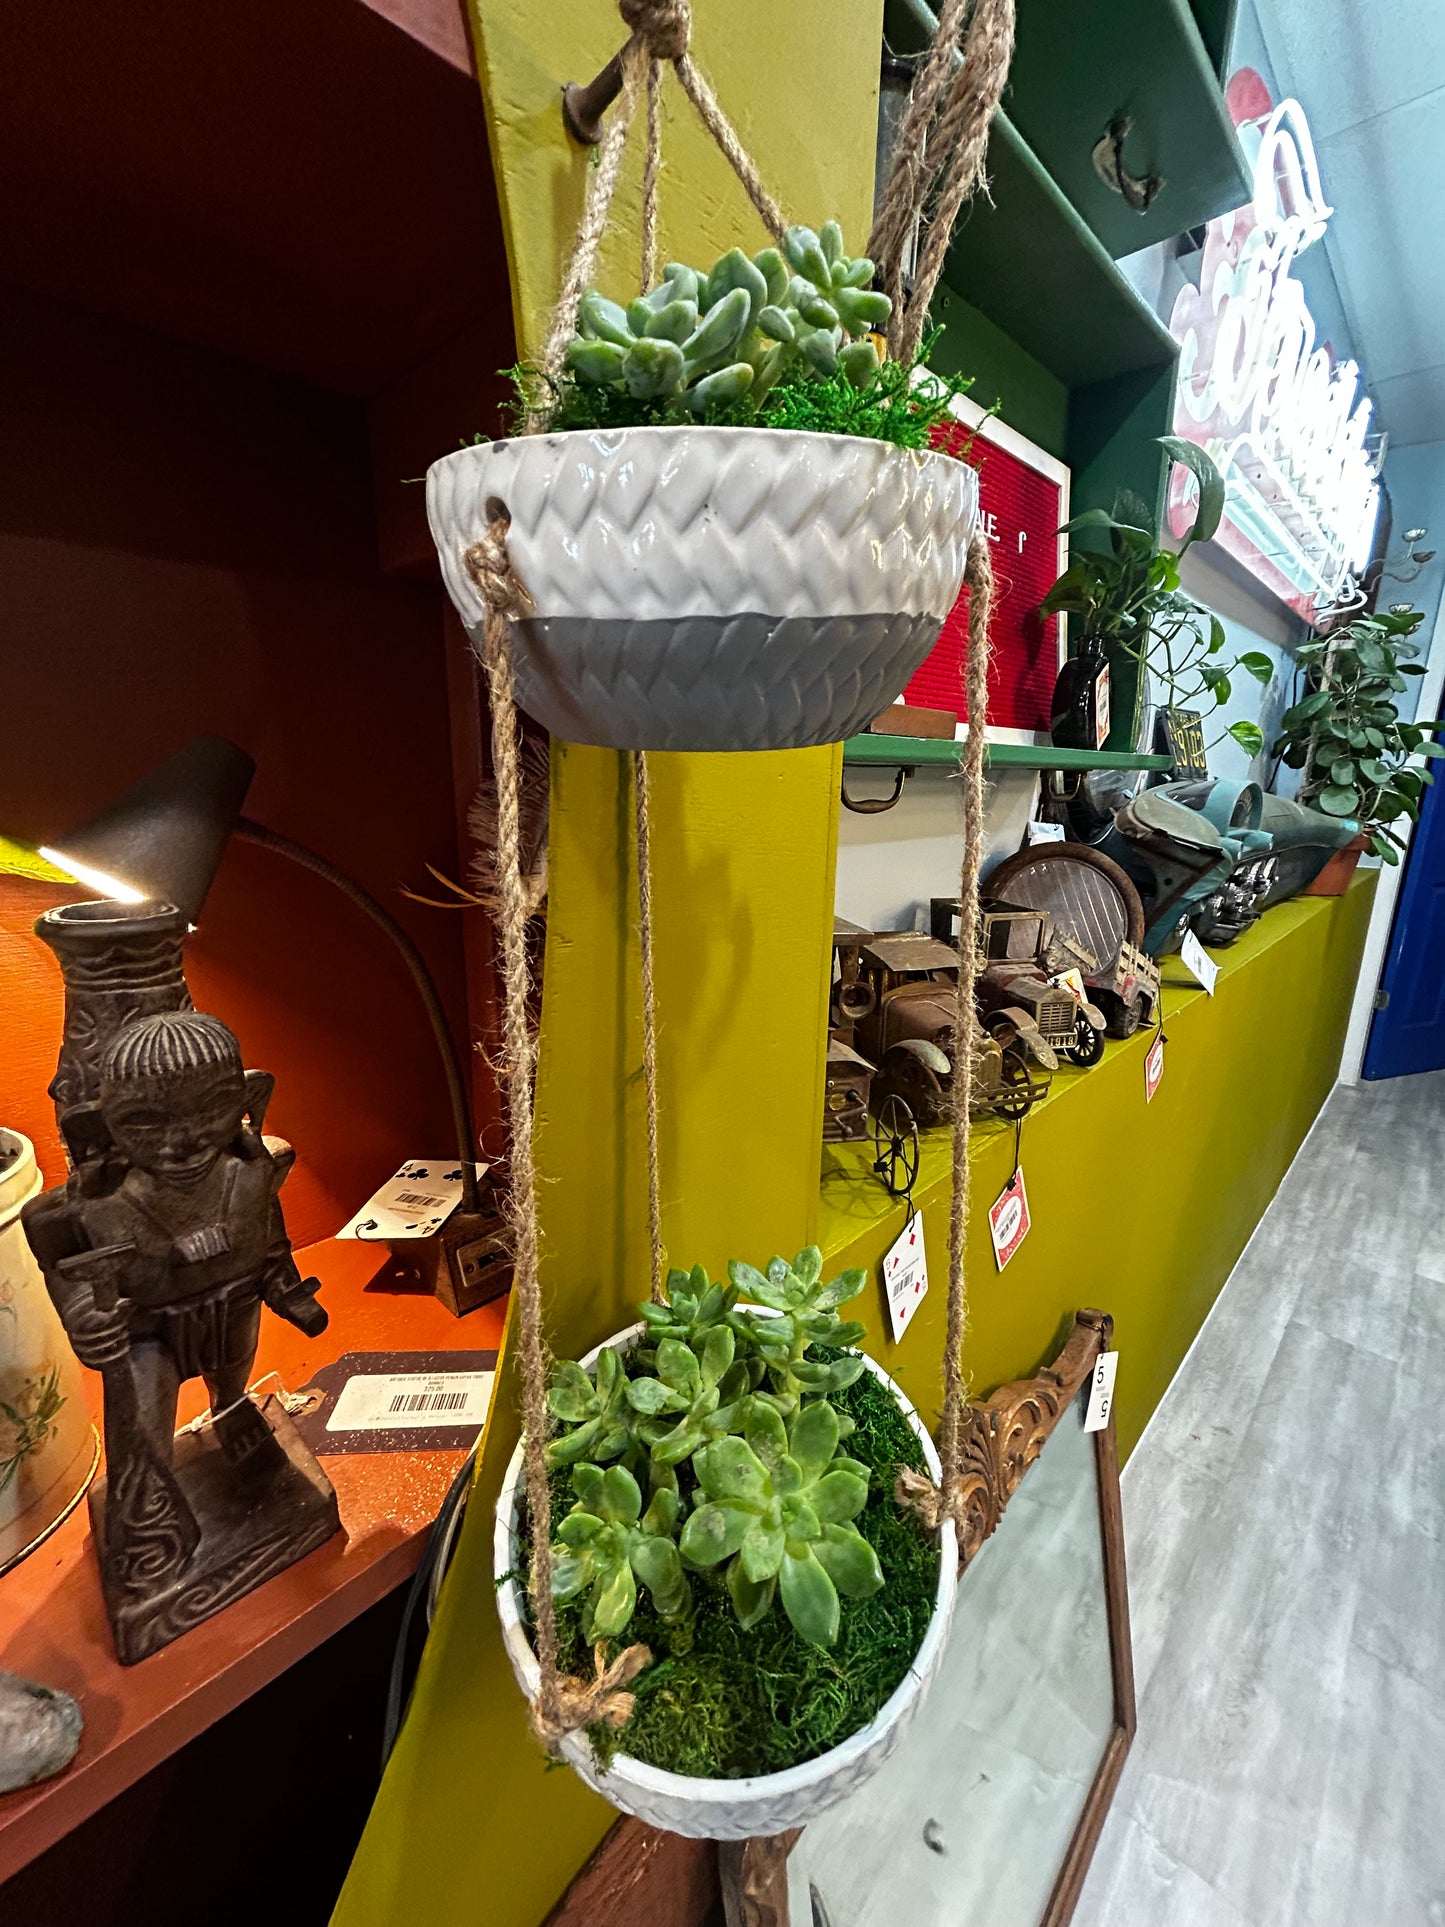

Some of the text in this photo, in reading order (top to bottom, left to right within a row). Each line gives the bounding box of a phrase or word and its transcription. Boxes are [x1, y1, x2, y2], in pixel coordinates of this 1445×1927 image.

[1050, 1036, 1074, 1047] 1918
[1097, 1366, 1105, 1384] 5
[1101, 1400, 1108, 1418] 5
